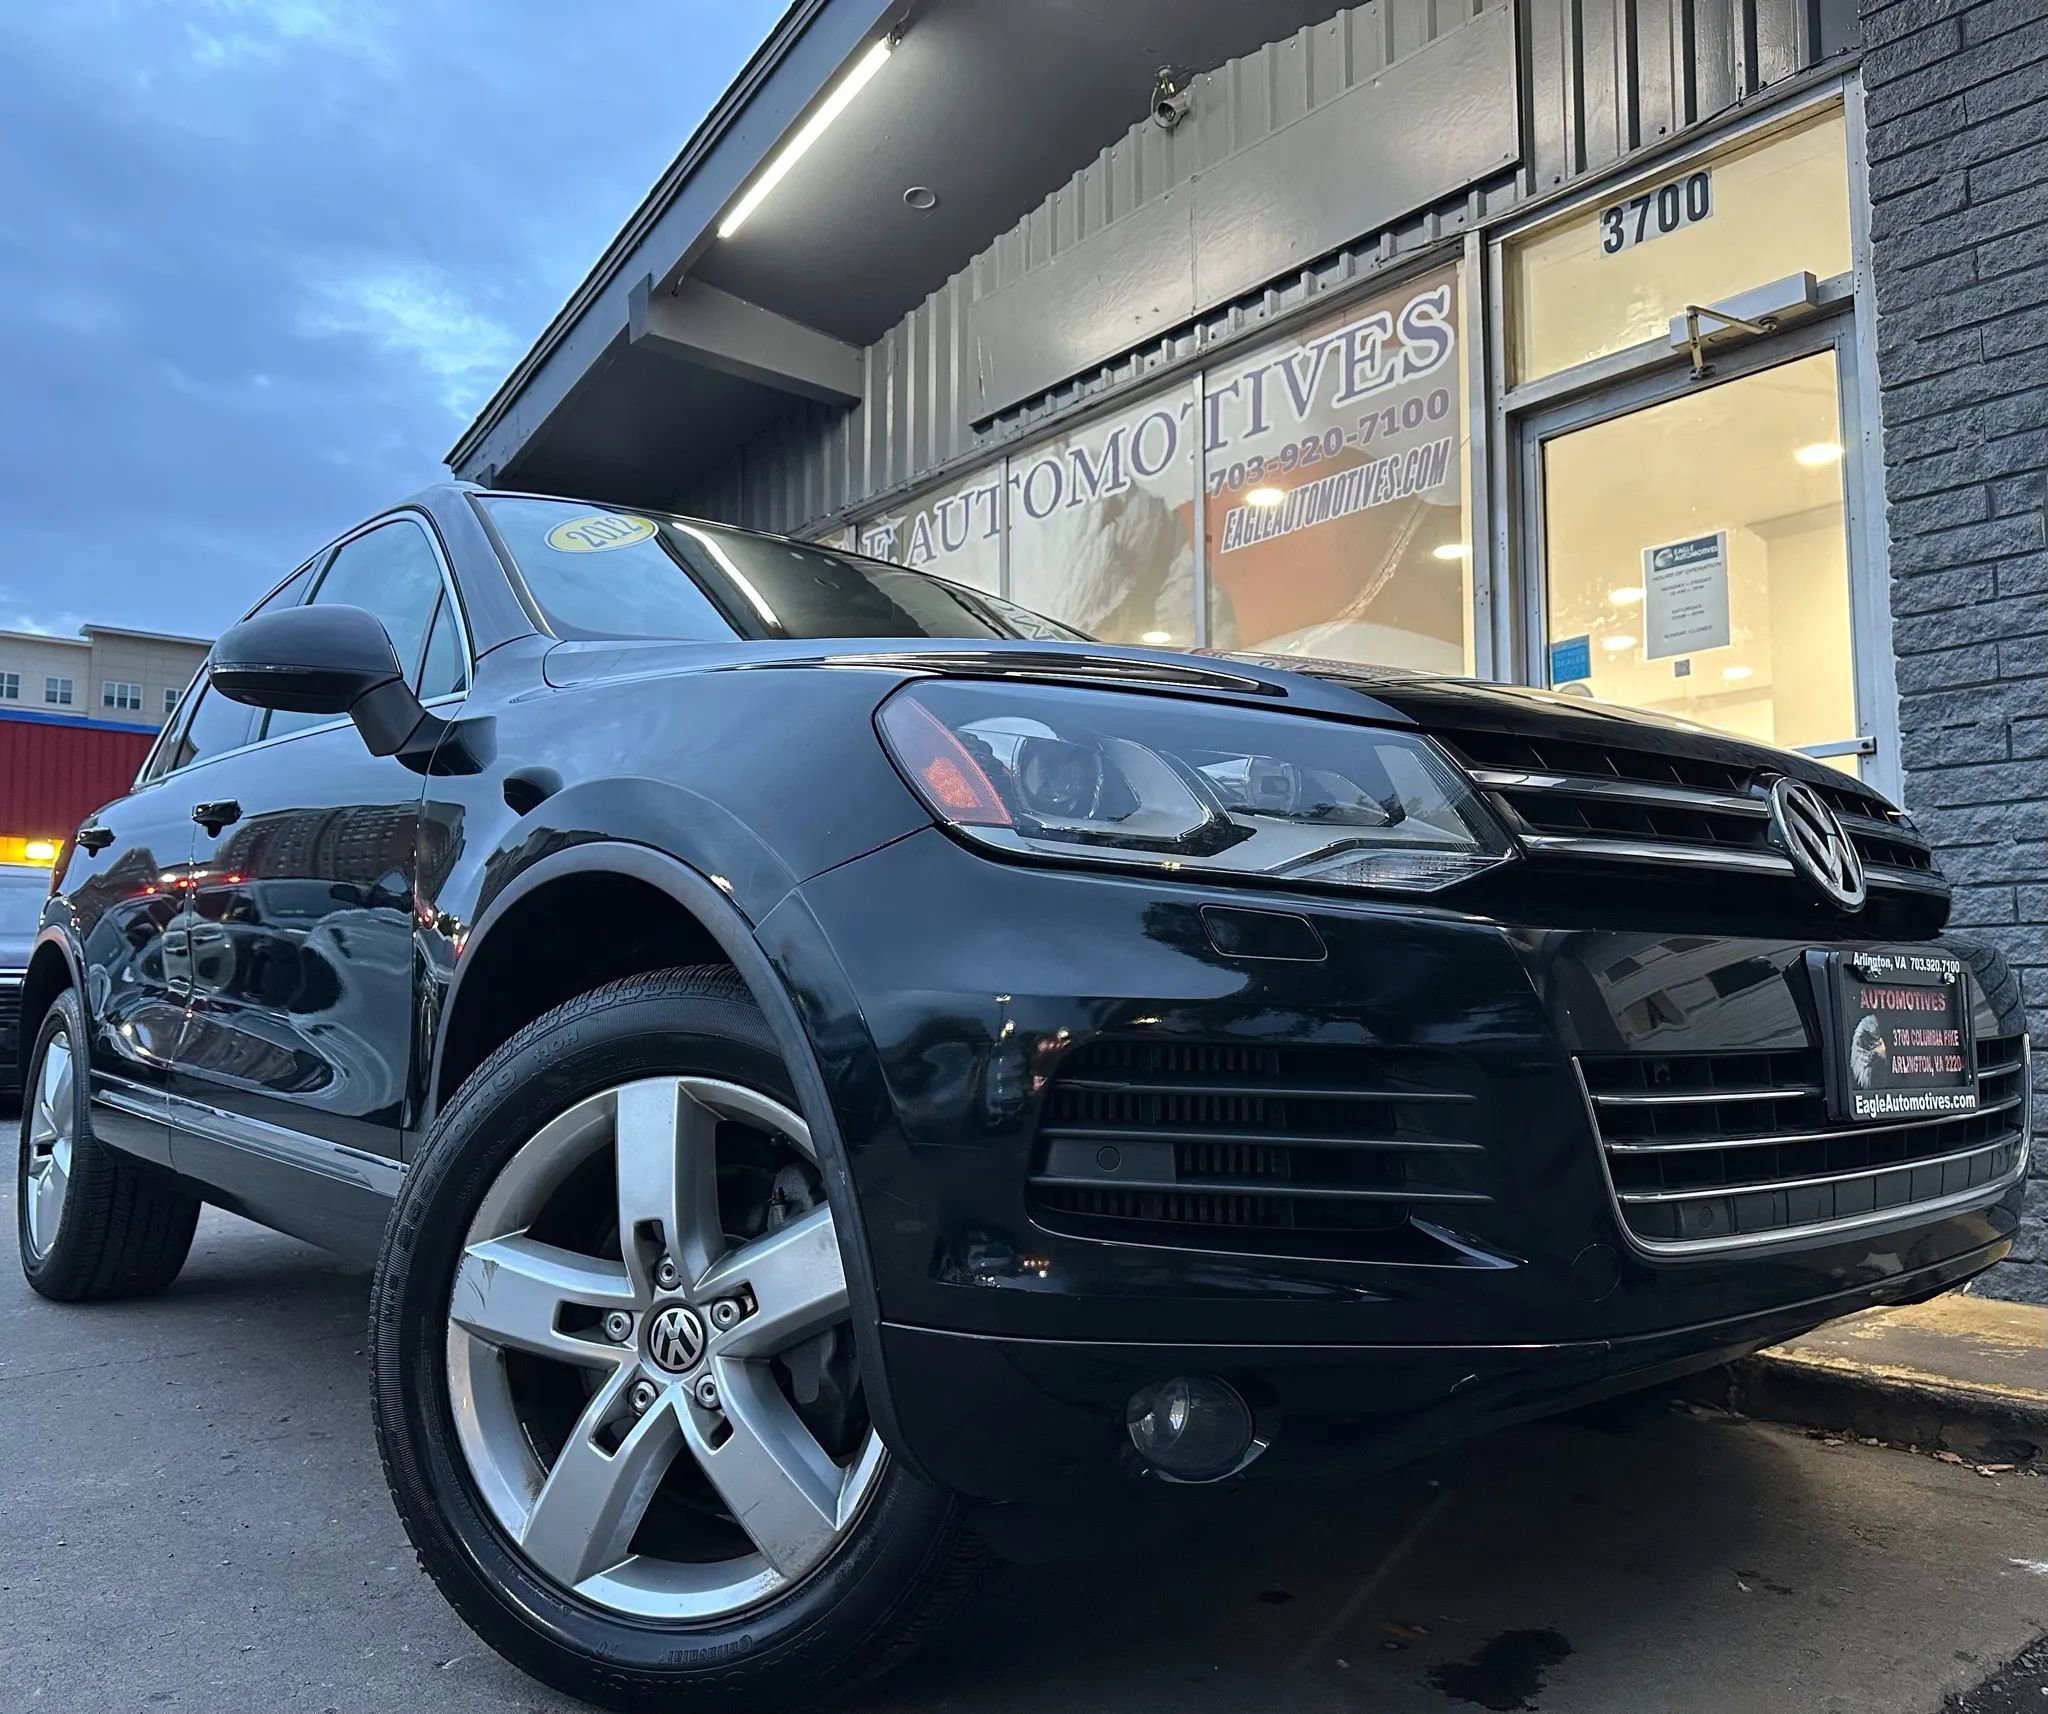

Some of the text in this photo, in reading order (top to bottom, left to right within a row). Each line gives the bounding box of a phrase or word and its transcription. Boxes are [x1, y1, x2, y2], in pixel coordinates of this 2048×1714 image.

[1604, 172, 1709, 254] 3700
[909, 287, 1451, 566] AUTOMOTIVES
[1209, 388, 1450, 497] 703-920-7100
[1222, 437, 1452, 552] EAGLEAUTOMOTIVES.COM
[565, 516, 643, 548] 2012
[1853, 952, 1960, 973] Arlington, VA 703.920.7100
[1860, 988, 1947, 1012] AUTOMOTIVES
[1910, 1029, 1943, 1047] COLUMBIA
[1944, 1029, 1960, 1047] PIKE
[1892, 1055, 1963, 1077] ARLINGTON, VA 2220
[1855, 1092, 1976, 1118] EagleAutomotives.com
